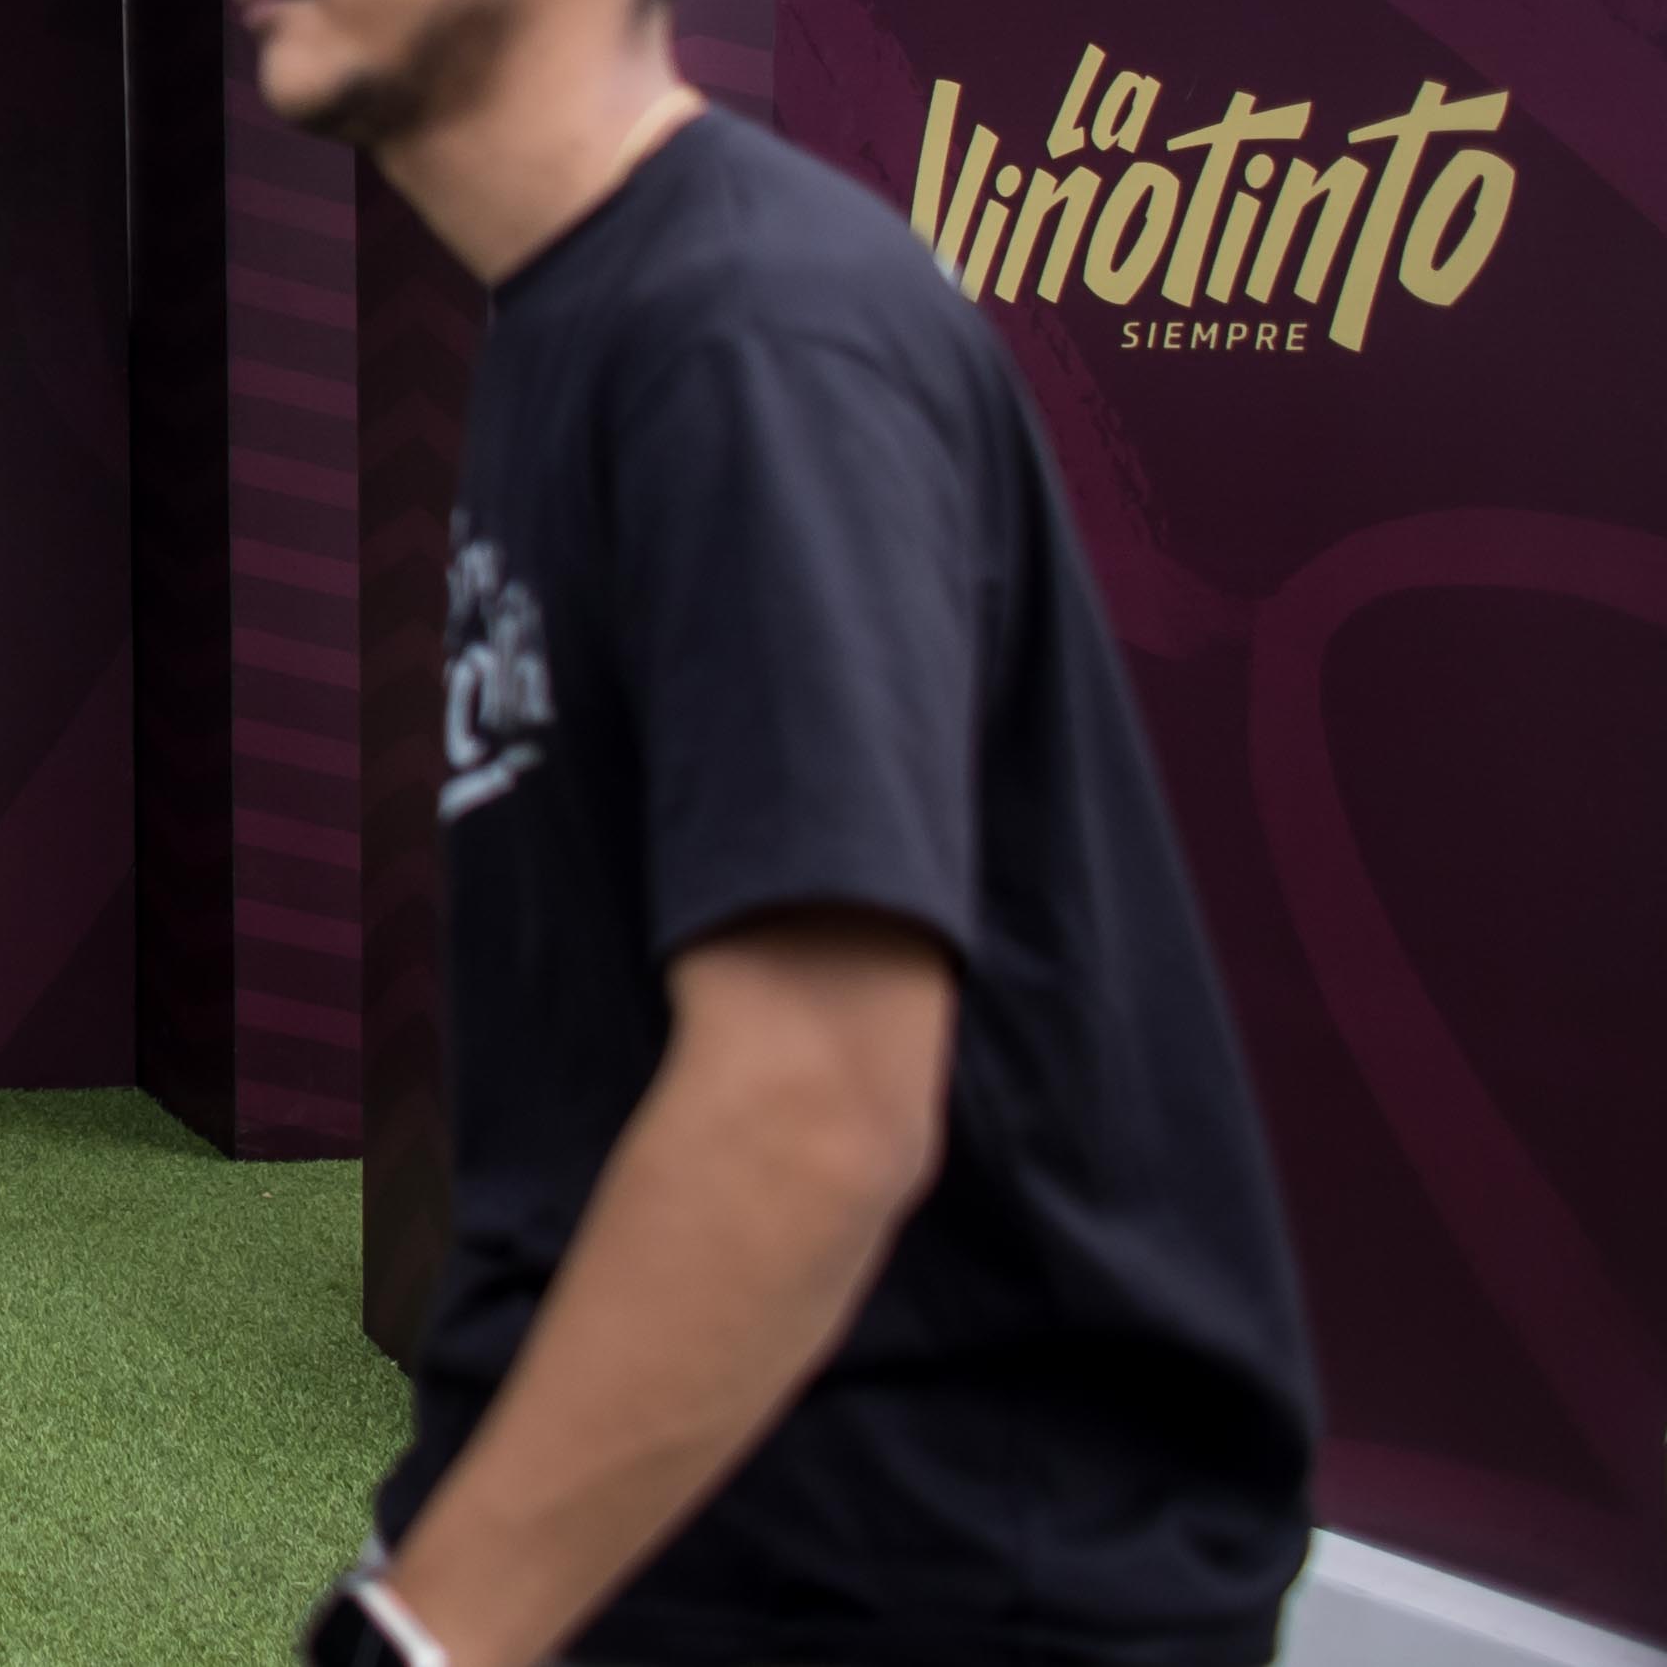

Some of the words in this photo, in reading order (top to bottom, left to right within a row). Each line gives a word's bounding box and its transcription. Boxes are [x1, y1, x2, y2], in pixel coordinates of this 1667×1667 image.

[1046, 42, 1162, 160] La
[909, 77, 1517, 352] Vinotinto
[1120, 320, 1309, 352] SIEMPRE
